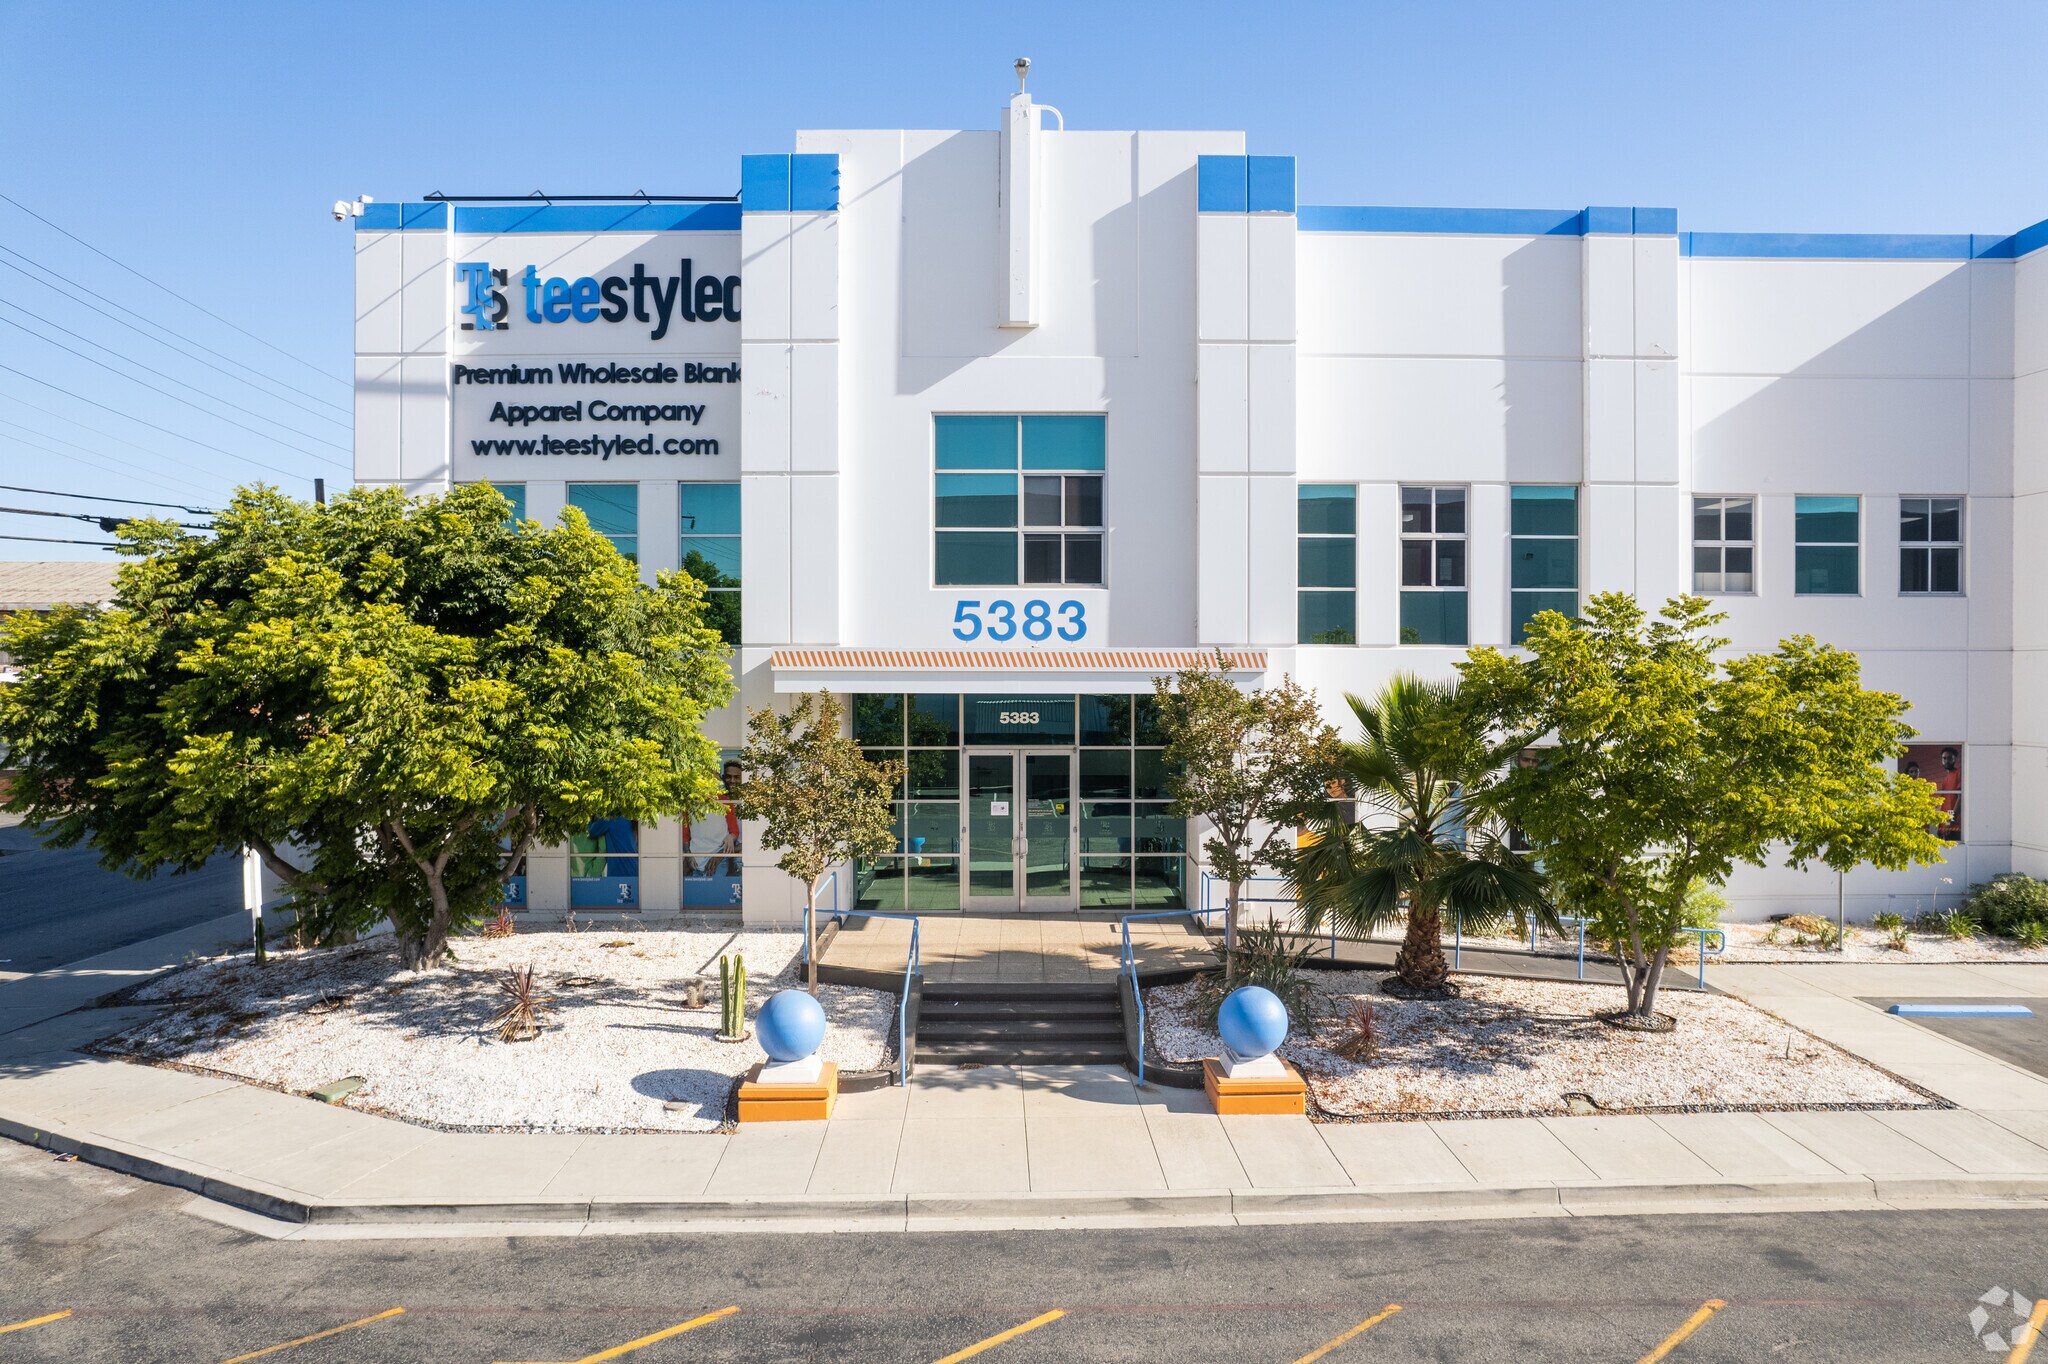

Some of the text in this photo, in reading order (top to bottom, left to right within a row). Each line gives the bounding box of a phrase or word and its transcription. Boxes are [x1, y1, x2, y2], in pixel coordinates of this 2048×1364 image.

[454, 363, 553, 385] Premium
[558, 362, 678, 384] Wholesale
[489, 400, 706, 427] Apparel Company
[471, 434, 719, 461] www.teestyled.com
[952, 599, 1087, 642] 5383
[999, 711, 1040, 724] 5383
